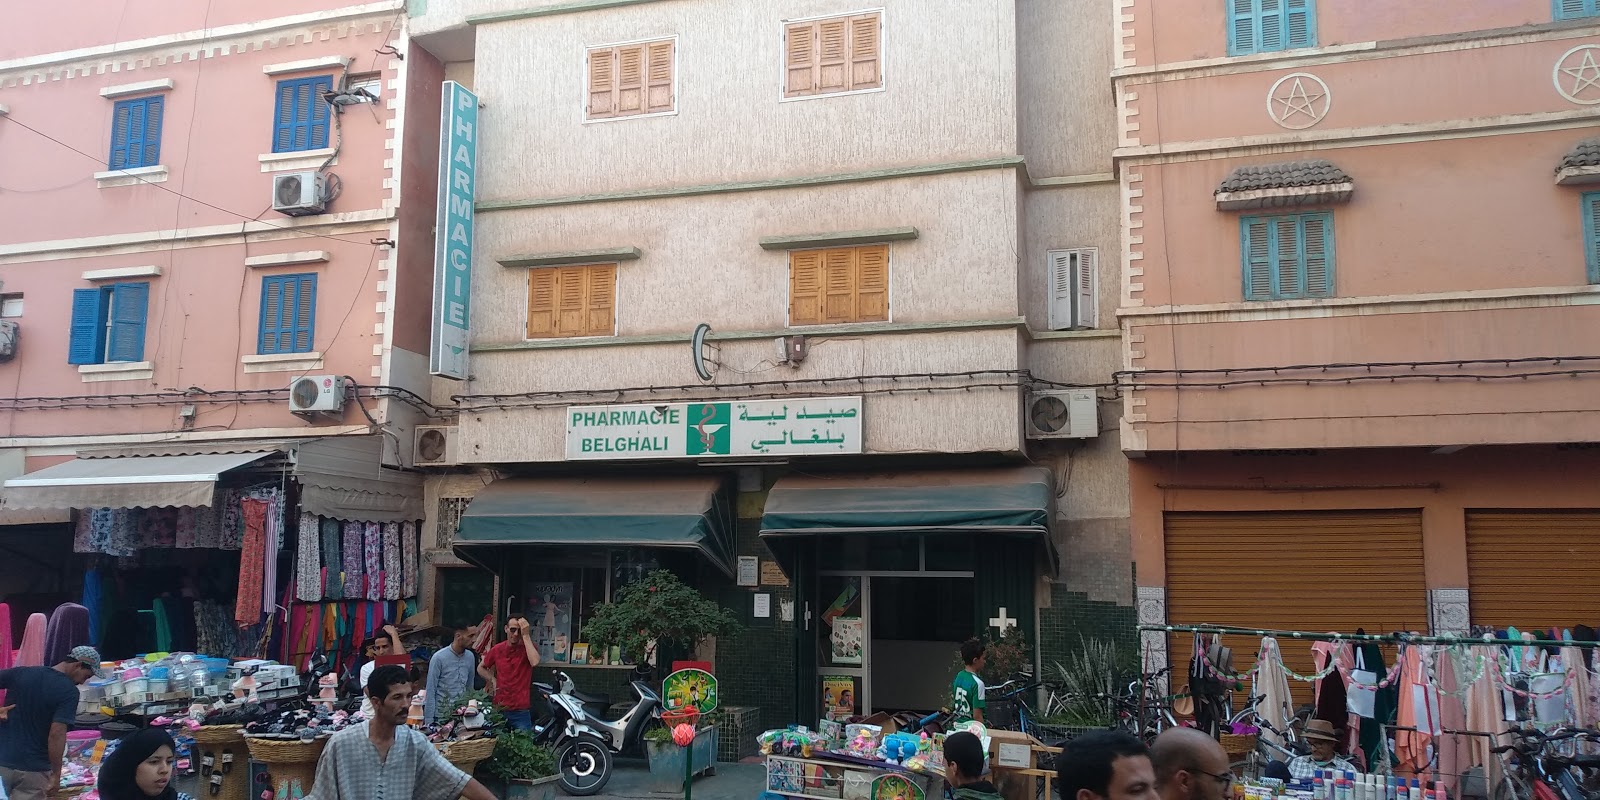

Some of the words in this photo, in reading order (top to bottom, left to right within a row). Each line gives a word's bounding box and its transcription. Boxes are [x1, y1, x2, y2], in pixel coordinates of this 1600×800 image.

[449, 90, 473, 324] PHARMACIE
[572, 409, 680, 427] PHARMACIE
[581, 436, 668, 452] BELGHALI
[751, 428, 845, 453] بلغالي
[954, 686, 971, 713] 55
